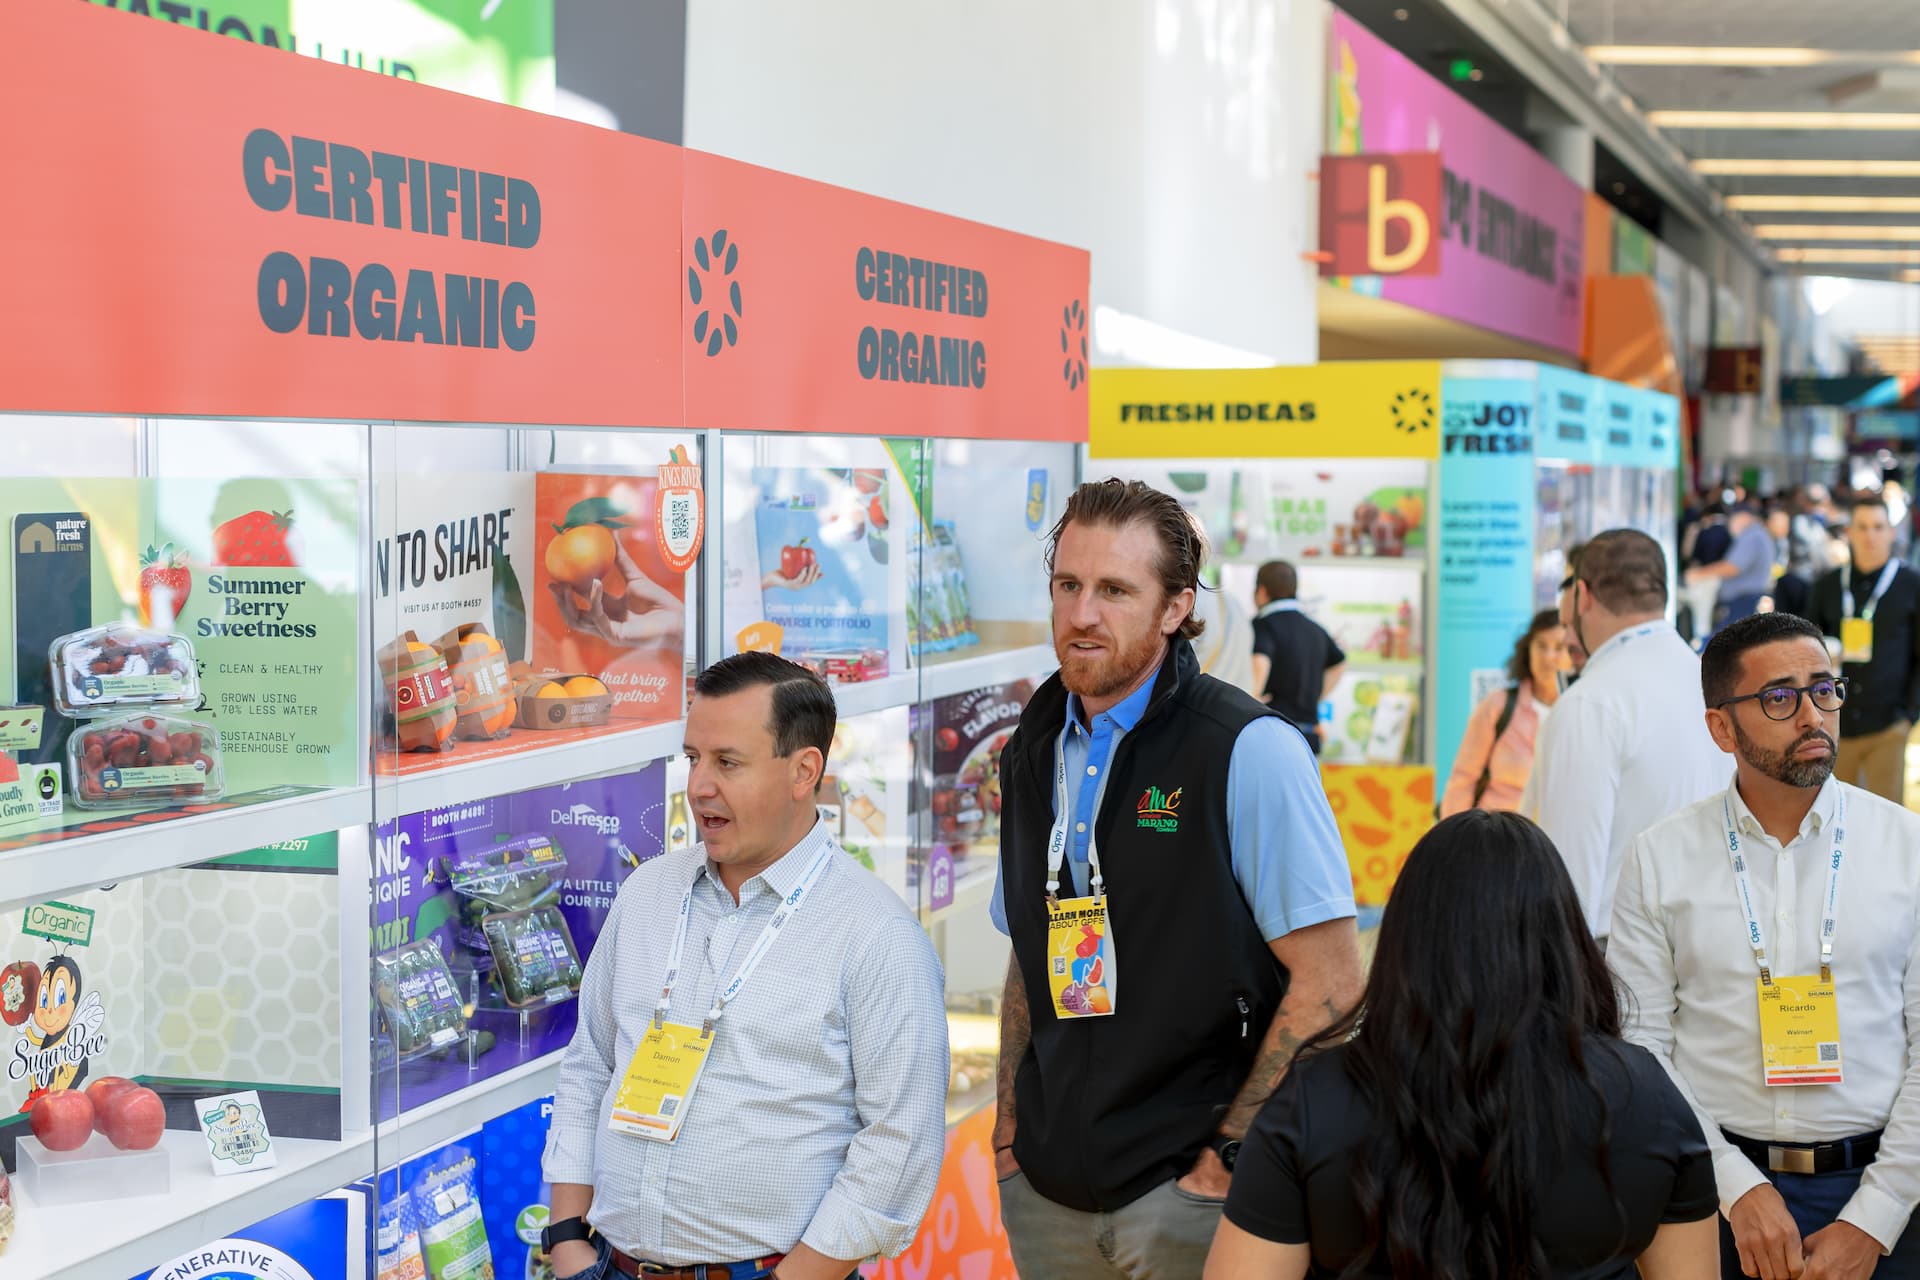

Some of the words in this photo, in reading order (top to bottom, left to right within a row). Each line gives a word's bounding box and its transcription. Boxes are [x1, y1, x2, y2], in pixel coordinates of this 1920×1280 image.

[242, 128, 541, 249] CERTIFIED
[1368, 164, 1430, 271] b
[856, 246, 988, 318] CERTIFIED
[257, 251, 536, 352] ORGANIC
[857, 326, 986, 389] ORGANIC
[1120, 403, 1215, 423] FRESH
[1224, 402, 1317, 422] IDEAS
[1473, 405, 1530, 427] JOY
[1445, 434, 1533, 453] FRESH
[56, 519, 85, 530] nature
[56, 530, 81, 540] fresh
[56, 541, 84, 552] farms
[398, 528, 426, 592] TO
[434, 508, 511, 582] SHARE
[208, 576, 305, 594] Summer
[225, 598, 289, 620] Berry
[404, 602, 419, 614] VISIT
[421, 602, 430, 611] US
[431, 602, 439, 611] AT
[441, 600, 461, 611] BOOTH
[197, 618, 317, 638] Sweetness
[771, 617, 811, 629] DIVERSE
[815, 618, 871, 629] PORTFOLIO
[220, 664, 256, 674] CLEAN
[260, 664, 267, 674] &
[274, 664, 323, 675] HEALTHY
[630, 672, 667, 691] bring
[221, 693, 255, 703] GROWN
[262, 693, 297, 704] USING
[221, 705, 242, 715] 70%
[249, 705, 278, 715] LESS
[283, 706, 318, 716] WATER
[963, 702, 1022, 738] FLAVOR
[220, 731, 295, 742] SUSTAINABLY
[221, 743, 288, 754] GREENHOUSE
[296, 744, 330, 754] GROWN
[4, 802, 34, 817] Grown
[551, 807, 620, 827] DelFresco
[431, 811, 460, 828] BOOTH
[1137, 819, 1178, 828] MARANO
[1052, 830, 1064, 853] Oppy
[1729, 831, 1739, 852] Oppy
[1831, 849, 1842, 871] Oppy
[564, 879, 572, 890] A
[575, 880, 612, 892] LITTLE
[565, 895, 591, 907] OUR
[787, 886, 804, 906] Oppy
[31, 905, 87, 934] Organic
[1049, 911, 1077, 922] LEARN
[1079, 908, 1105, 919] MORE
[1049, 919, 1078, 930] ABOUT
[1750, 921, 1760, 943] Oppy
[723, 977, 742, 997] Oppy
[1780, 1004, 1816, 1013] Ricardo
[8, 1023, 105, 1087] SugarBee
[653, 1051, 681, 1064] Damon
